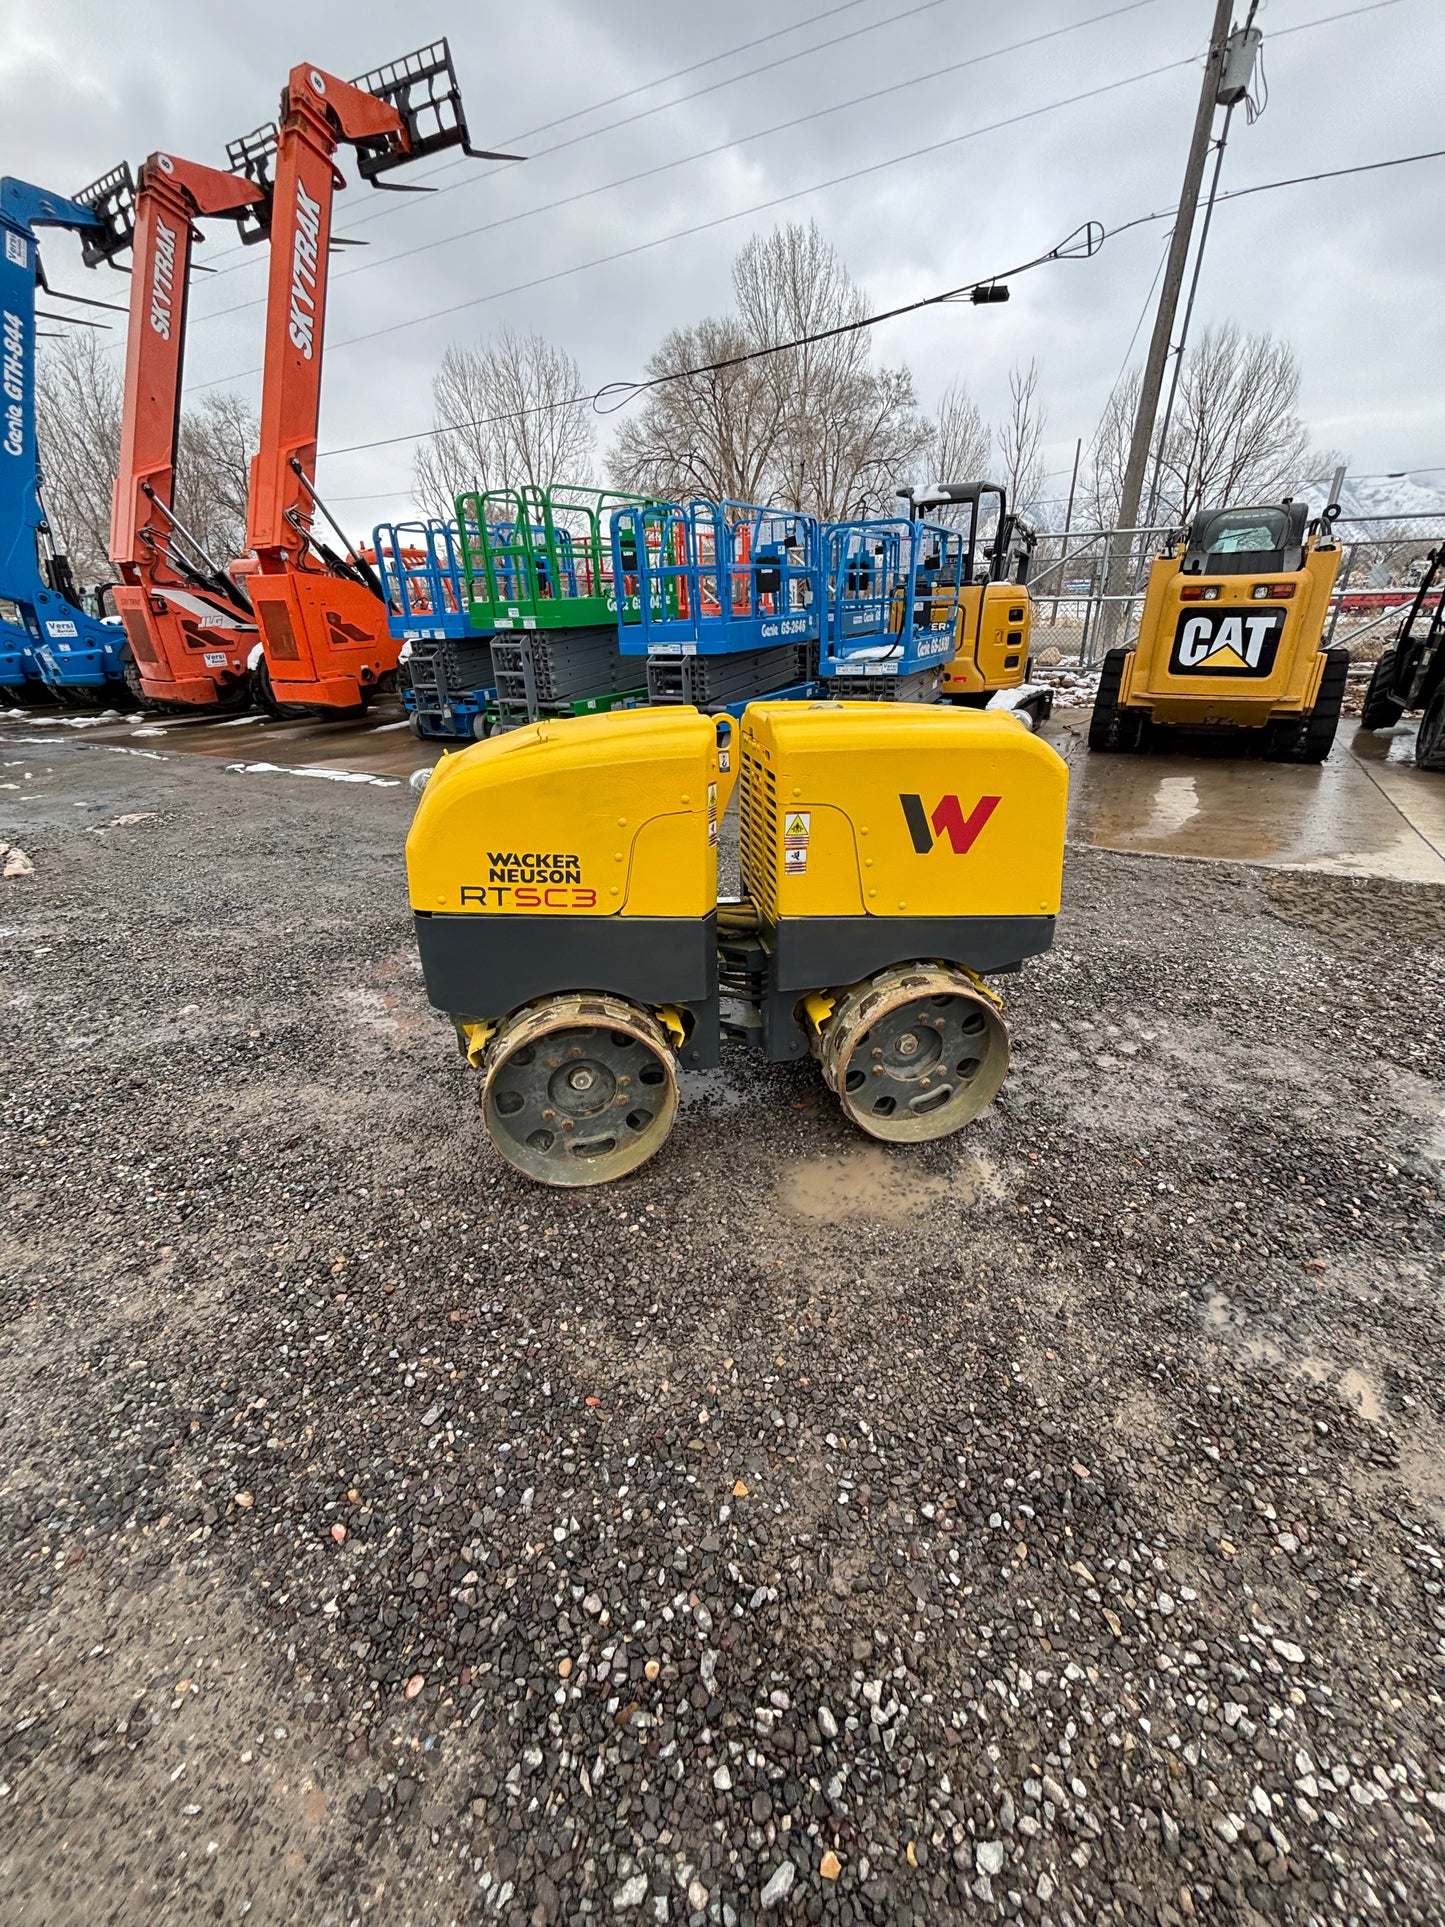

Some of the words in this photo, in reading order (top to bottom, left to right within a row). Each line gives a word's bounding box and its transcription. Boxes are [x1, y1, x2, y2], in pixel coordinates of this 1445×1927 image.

[289, 176, 320, 360] SKYTRAK
[150, 215, 176, 341] SKYTRAK
[3, 310, 24, 401] GTH-844
[3, 404, 23, 456] Genie
[606, 598, 629, 612] Gee
[48, 622, 74, 630] Versi
[198, 615, 223, 628] JLG
[761, 623, 779, 638] Genie
[917, 641, 930, 658] Genie
[1178, 617, 1277, 668] CAT
[205, 652, 225, 661] Versi
[486, 852, 580, 869] WACKER
[489, 868, 581, 884] NEUSON
[460, 886, 597, 908] RTSC3
